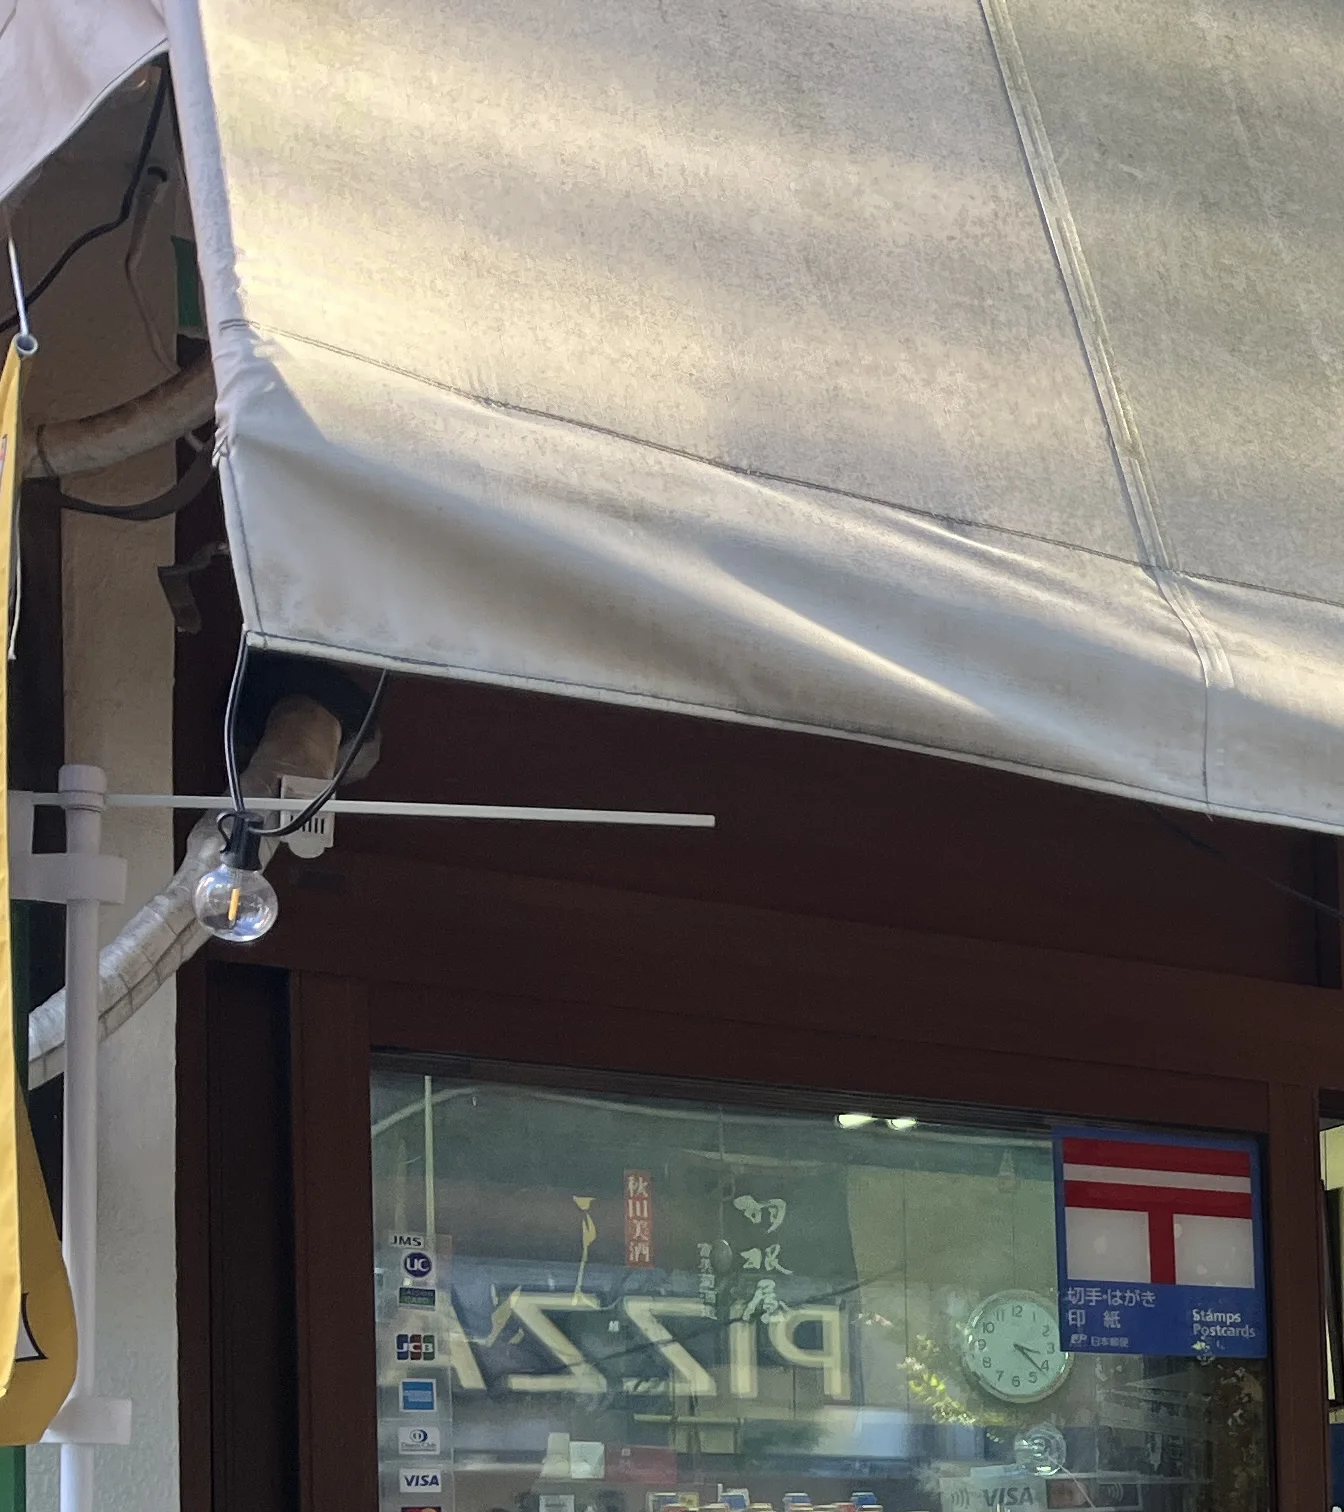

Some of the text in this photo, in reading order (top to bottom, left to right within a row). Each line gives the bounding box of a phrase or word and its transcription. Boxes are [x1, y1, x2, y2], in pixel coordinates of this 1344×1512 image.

[390, 1235, 422, 1247] JMS
[406, 1257, 430, 1273] UC
[1067, 1286, 1157, 1308] 切手・はがき
[1192, 1308, 1242, 1324] Stamps
[1192, 1323, 1256, 1340] Postcards
[397, 1341, 435, 1353] JCB
[1091, 1336, 1129, 1348] 日本郵便
[405, 1474, 439, 1487] VISA
[983, 1485, 1034, 1507] VISA
